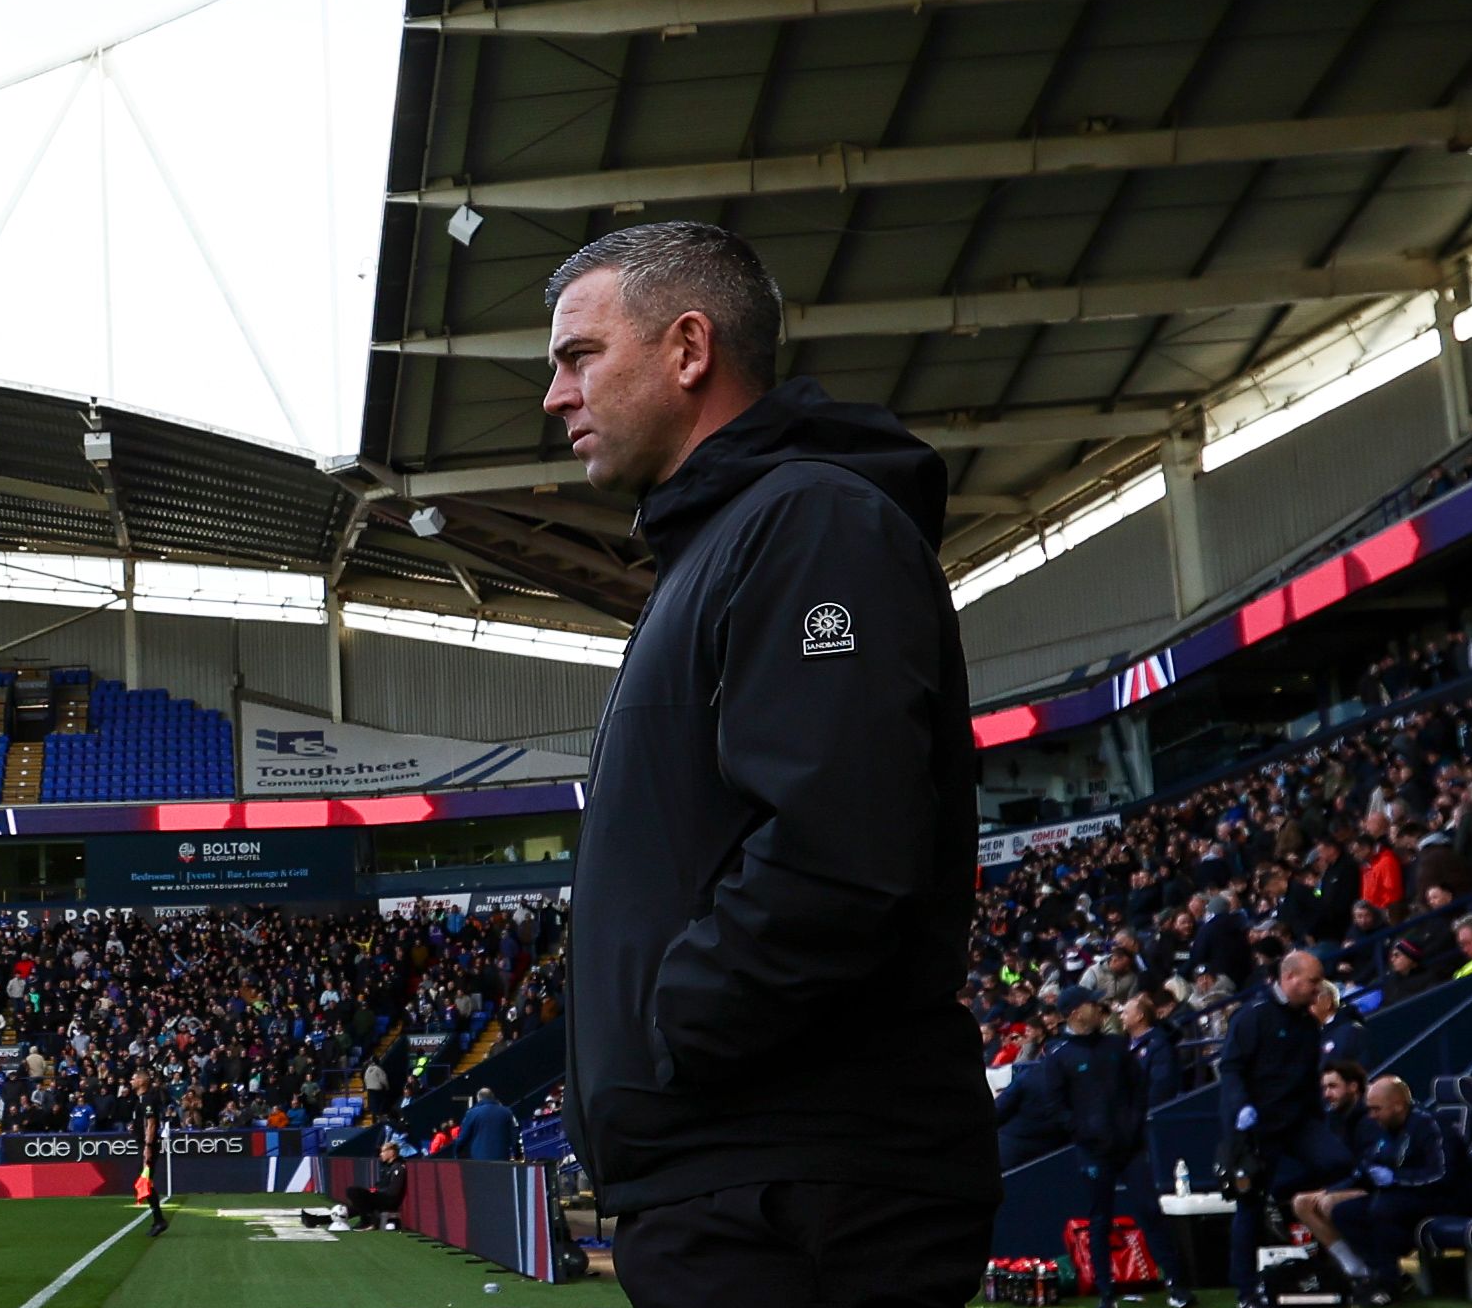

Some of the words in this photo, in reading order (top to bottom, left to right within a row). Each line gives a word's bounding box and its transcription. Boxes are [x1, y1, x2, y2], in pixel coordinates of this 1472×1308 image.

[257, 758, 419, 779] Toughsheet
[257, 776, 351, 787] Community
[354, 772, 421, 785] Stadium
[1031, 831, 1055, 842] COME
[1056, 827, 1070, 838] ON
[202, 842, 262, 855] BOLTON
[237, 853, 261, 861] HOTEL
[978, 851, 1002, 863] OLTON
[131, 872, 175, 882] Bedrooms
[186, 870, 216, 882] Events
[24, 1138, 71, 1157] dale
[73, 1136, 139, 1161] jones
